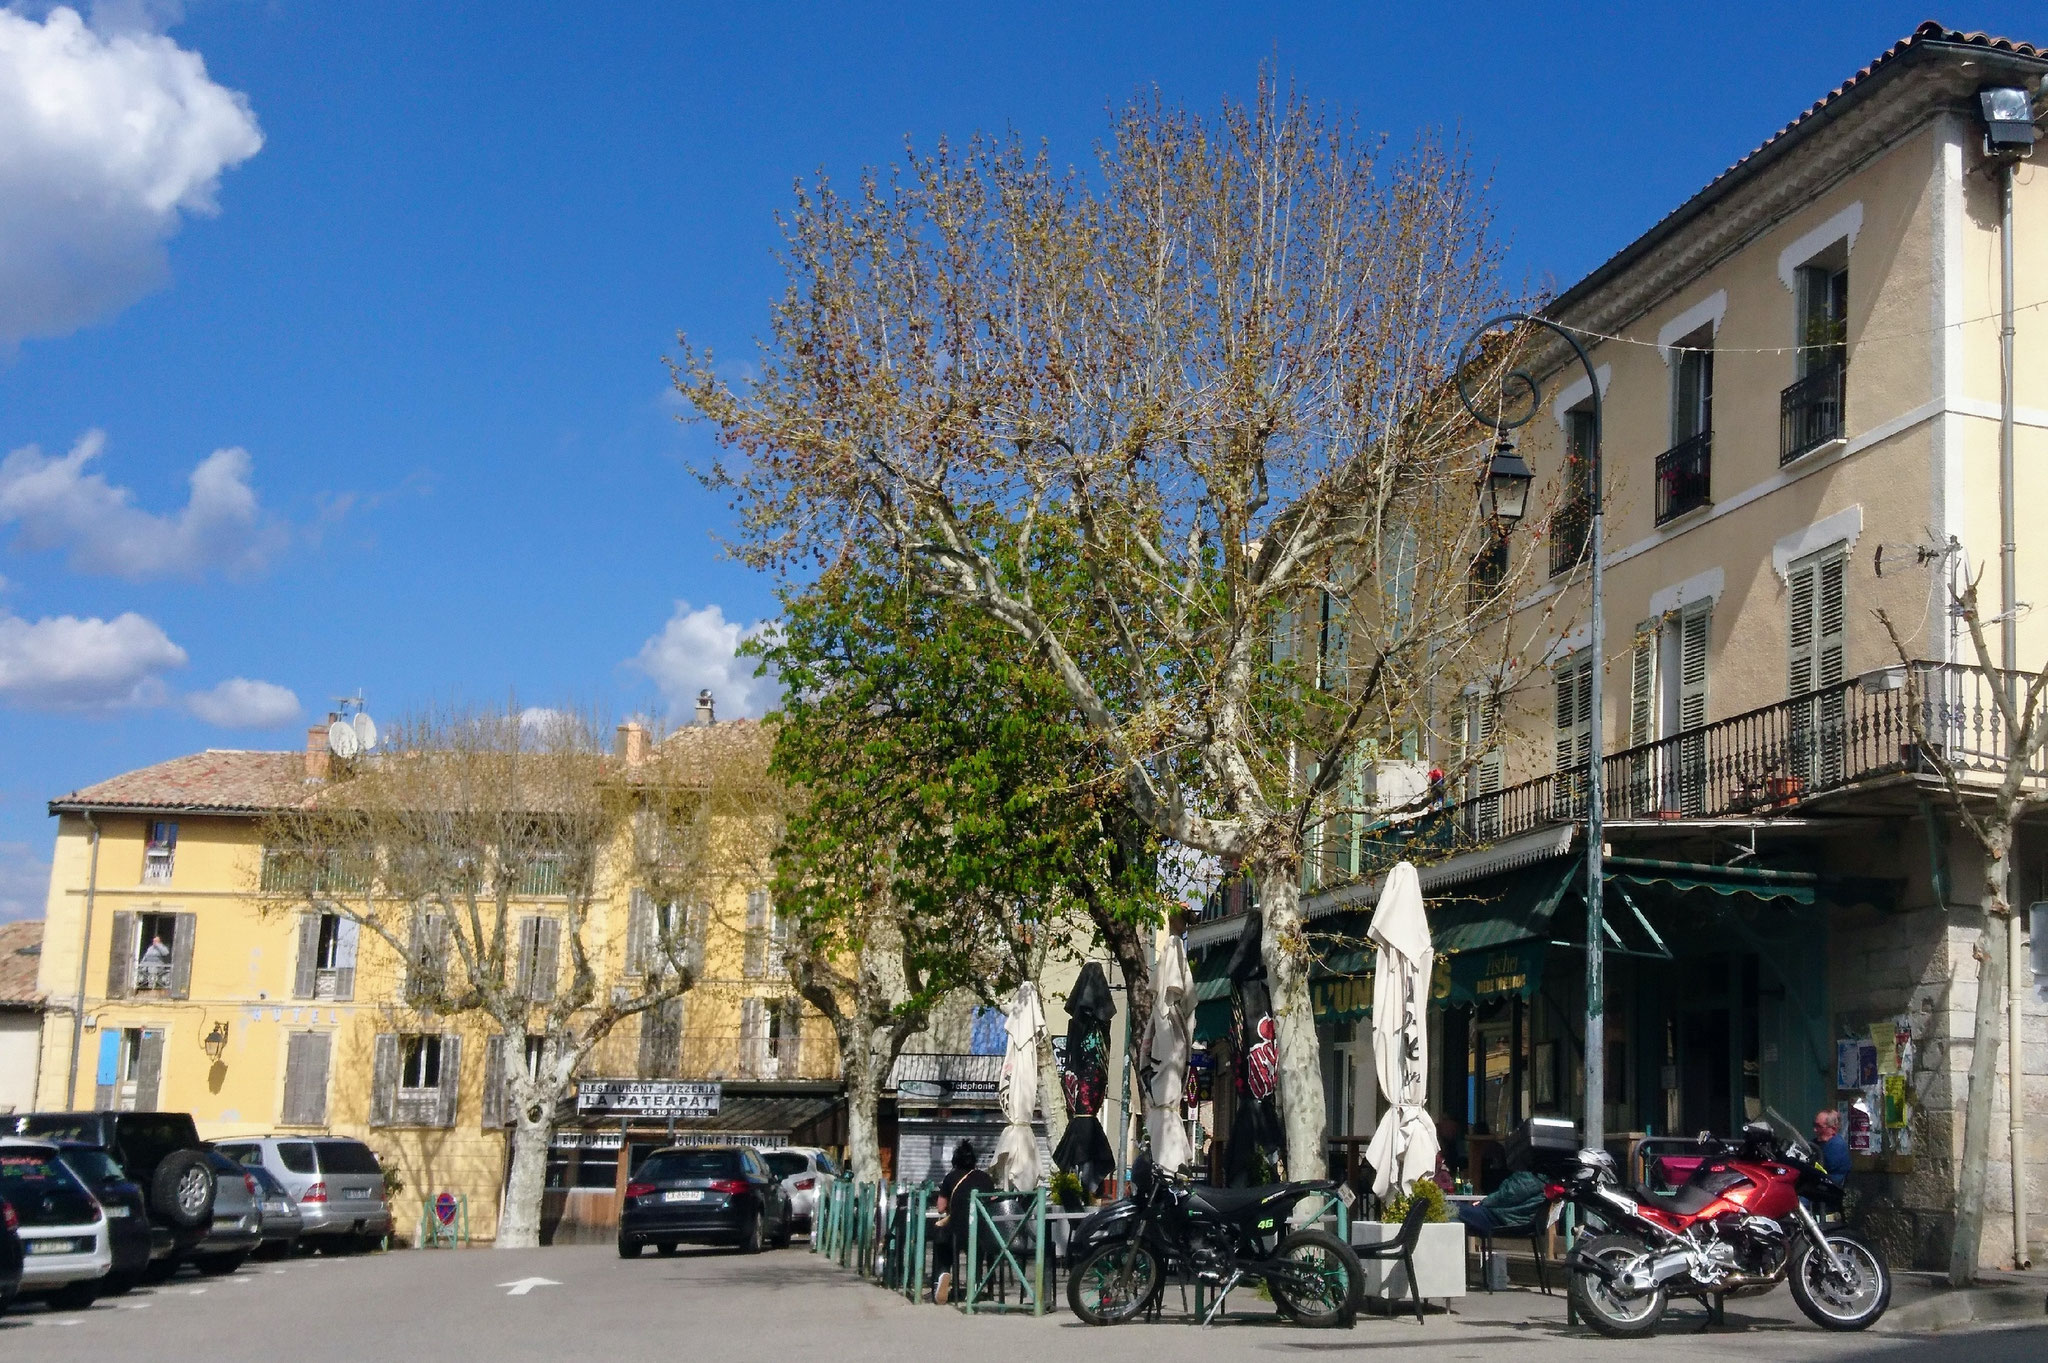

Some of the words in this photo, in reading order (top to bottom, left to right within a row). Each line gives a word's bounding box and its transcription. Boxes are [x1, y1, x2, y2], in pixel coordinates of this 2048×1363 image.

[583, 1084, 653, 1093] RESTAURANT
[666, 1085, 717, 1093] PIZZERIA
[951, 1082, 995, 1090] Téléphonie
[585, 1095, 608, 1105] LA
[617, 1096, 713, 1106] PATEAPAT
[562, 1136, 620, 1145] EMPORTER
[677, 1136, 721, 1147] CUISINE
[1257, 1219, 1274, 1229] 46
